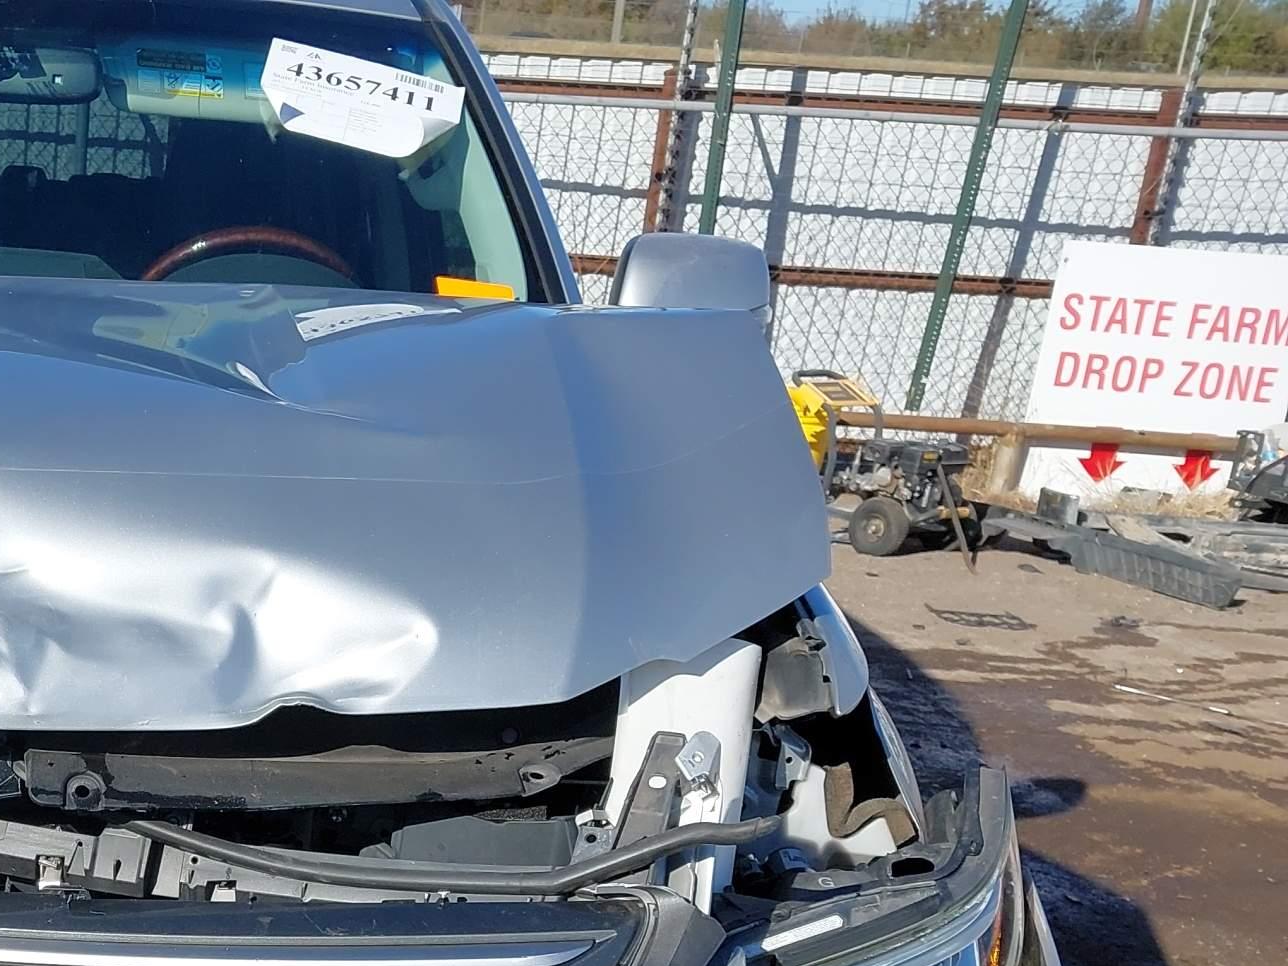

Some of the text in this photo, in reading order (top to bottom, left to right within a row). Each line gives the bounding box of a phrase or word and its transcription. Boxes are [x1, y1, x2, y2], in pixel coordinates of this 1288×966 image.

[286, 62, 435, 112] 43657411
[1059, 293, 1288, 346] STATE FARM
[1053, 351, 1279, 404] DROP ZONE
